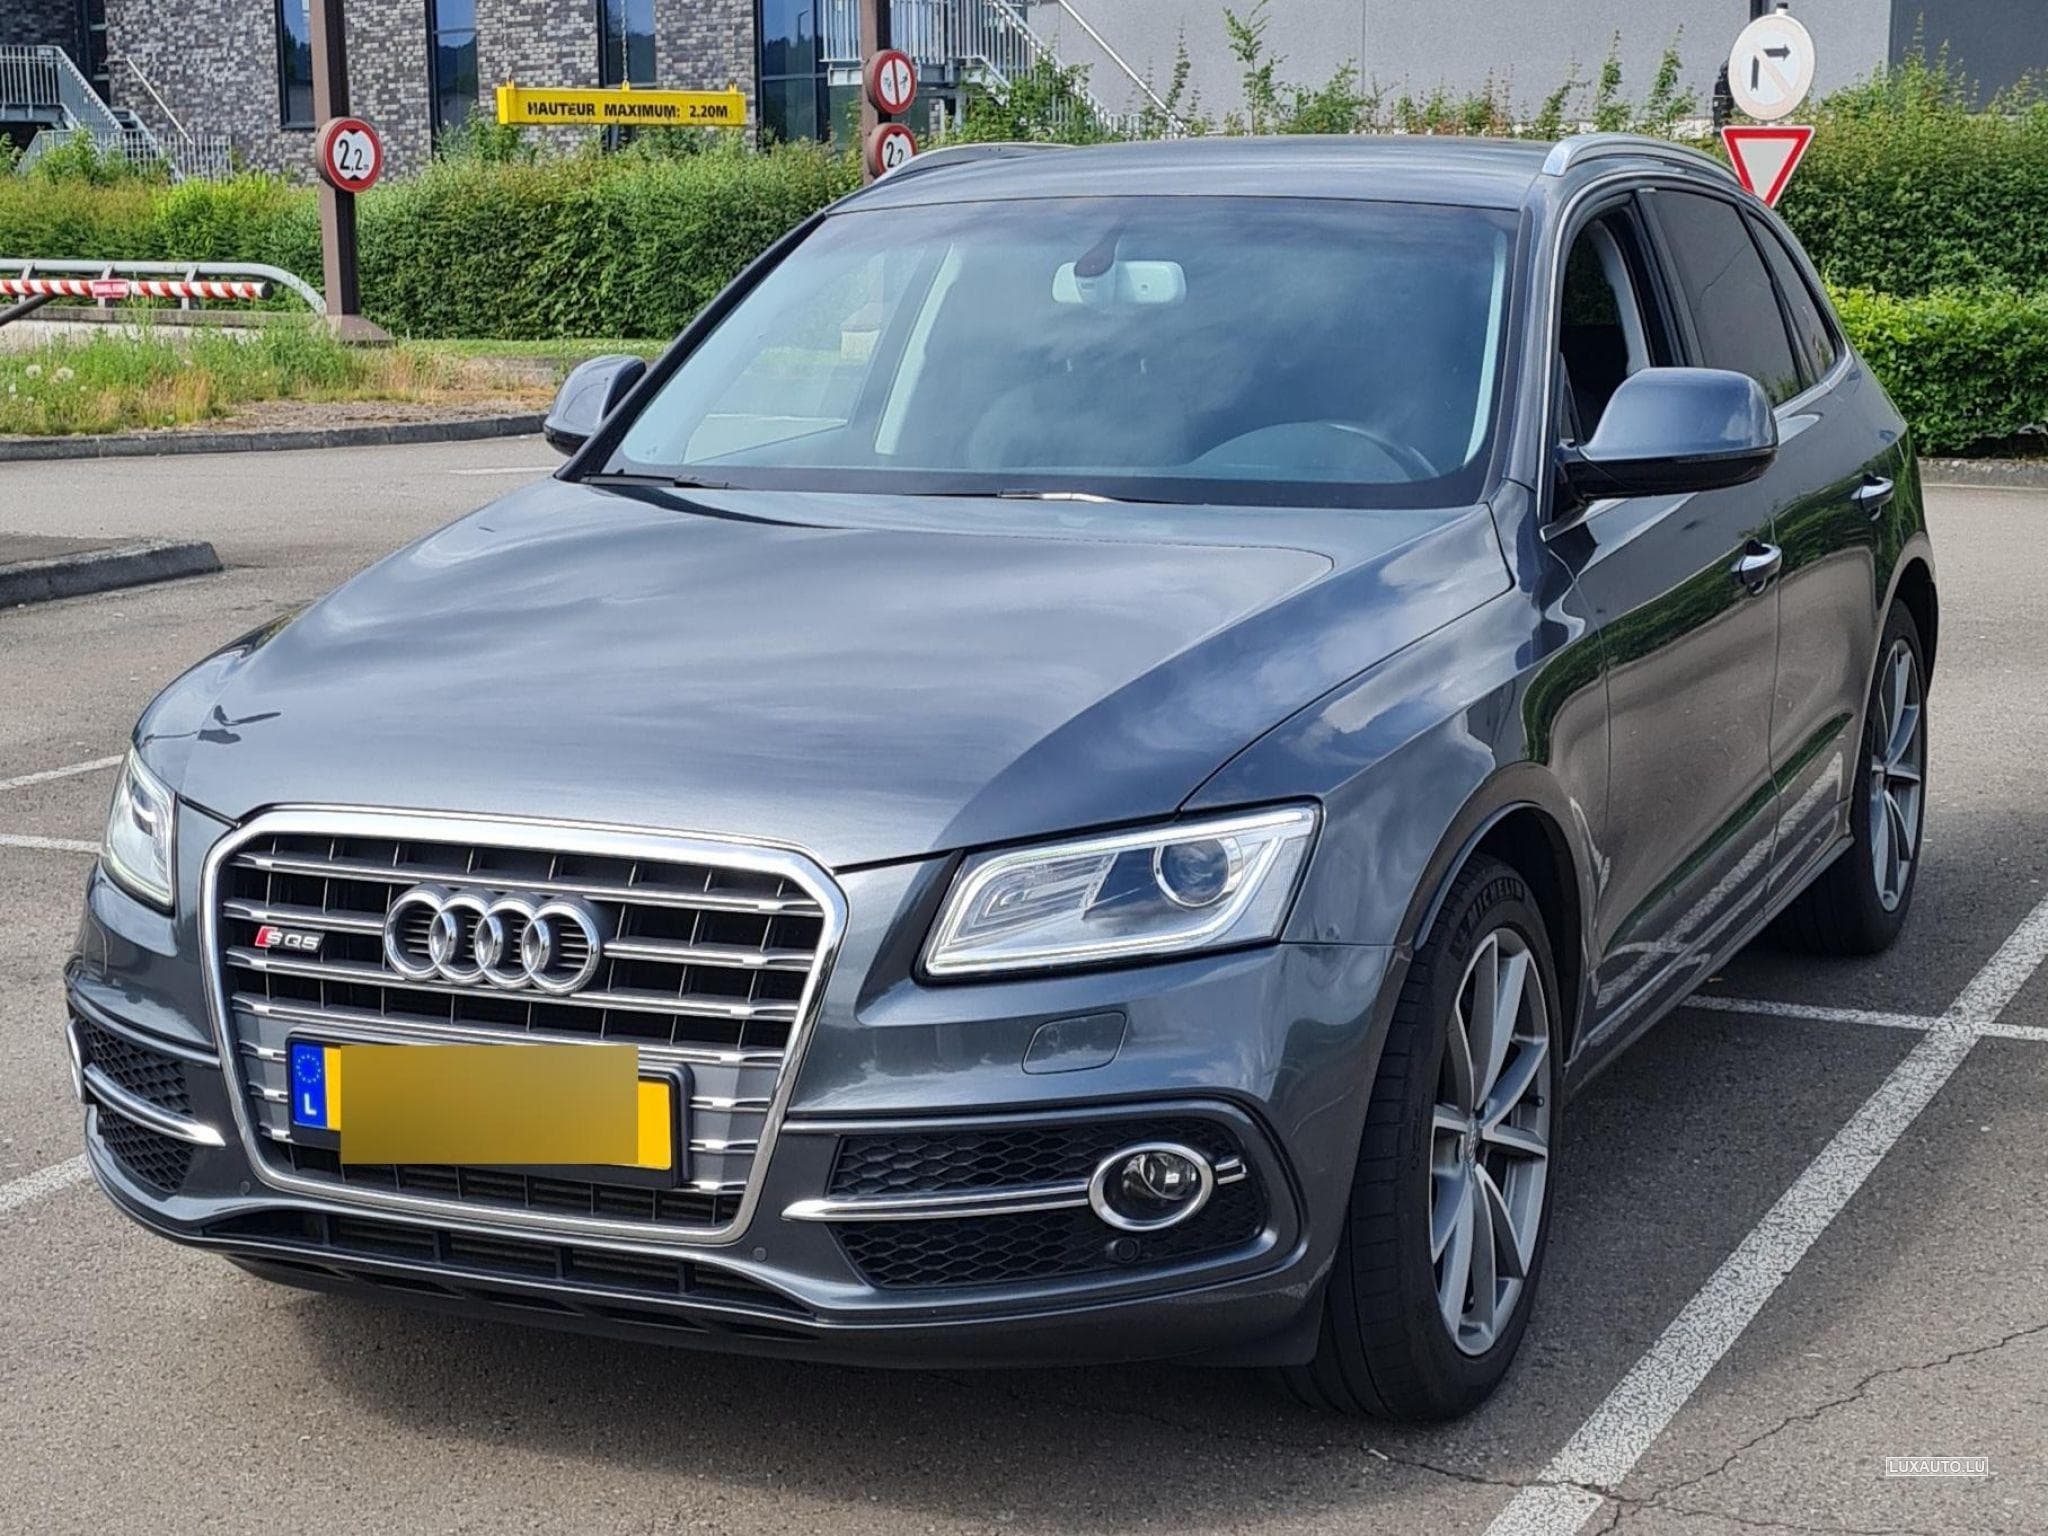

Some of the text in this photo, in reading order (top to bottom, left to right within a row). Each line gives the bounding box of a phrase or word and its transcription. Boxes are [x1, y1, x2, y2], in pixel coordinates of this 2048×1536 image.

[528, 102, 728, 118] HAUTEUR MAXIMUM: 2.20M
[1467, 878, 1525, 930] MICHELIN
[305, 1093, 317, 1116] L
